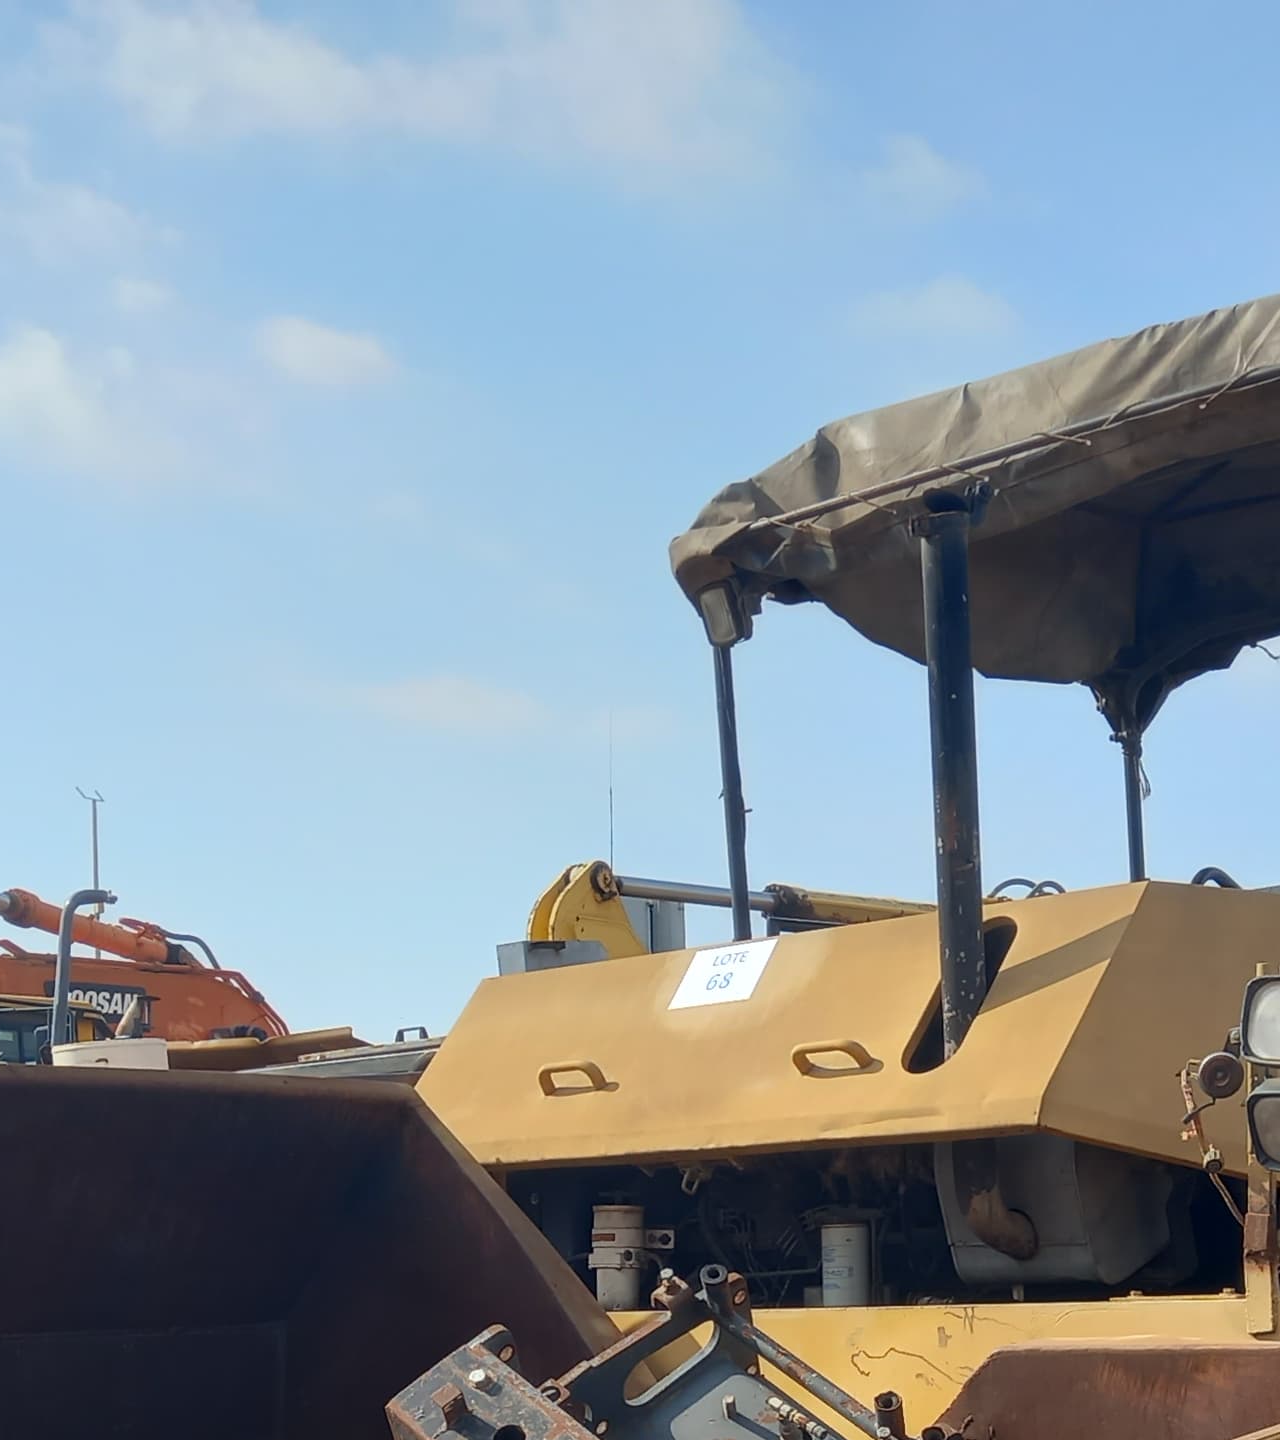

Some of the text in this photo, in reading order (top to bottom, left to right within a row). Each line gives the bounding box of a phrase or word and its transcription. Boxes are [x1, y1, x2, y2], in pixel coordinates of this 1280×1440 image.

[712, 951, 750, 967] LOTE
[706, 972, 734, 991] 68
[67, 989, 139, 1014] OOSAN
